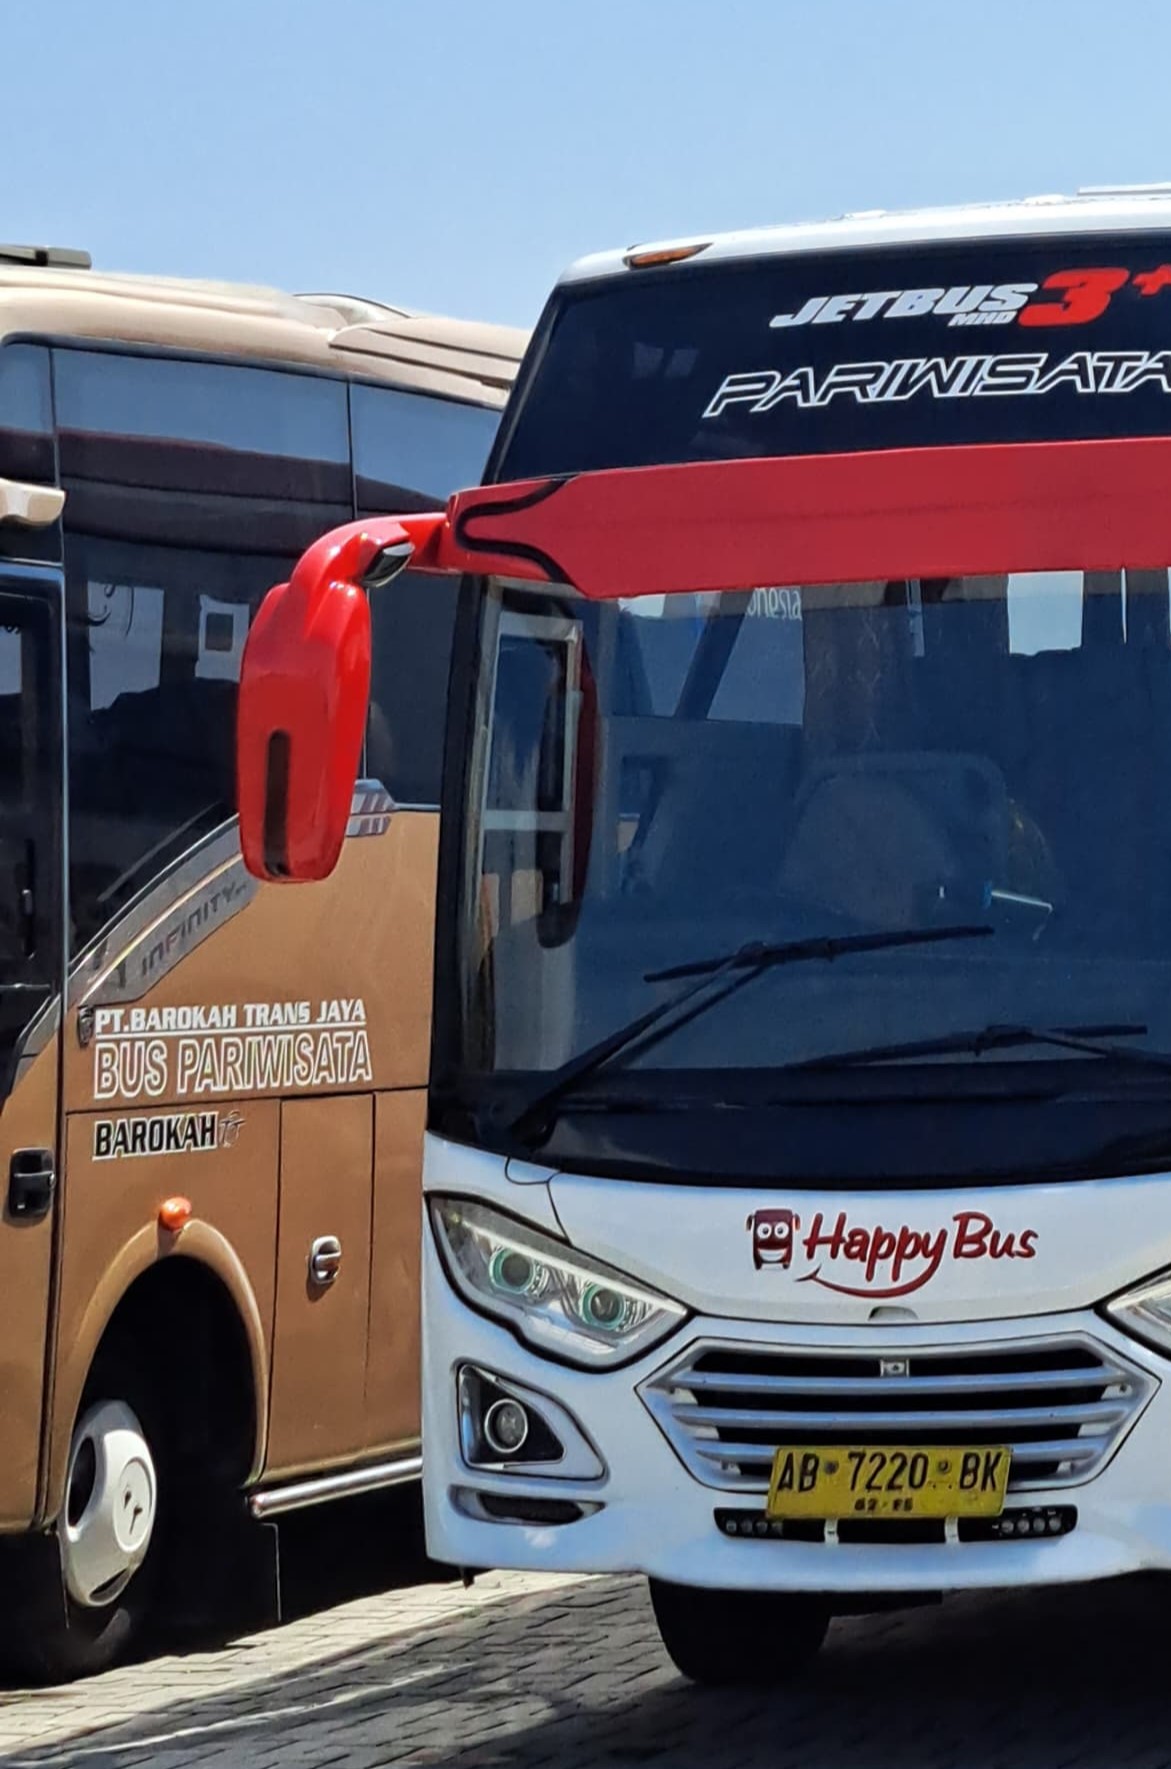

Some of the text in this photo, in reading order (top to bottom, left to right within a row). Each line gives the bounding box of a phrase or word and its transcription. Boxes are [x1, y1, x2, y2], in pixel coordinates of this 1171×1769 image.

[769, 283, 1038, 328] JETBUS
[243, 1001, 310, 1027] TRANS
[316, 999, 367, 1023] JAYA
[94, 1030, 373, 1099] BUS PARIWISATA
[92, 1110, 219, 1161] BAROKAH
[797, 1211, 1039, 1298] Happy Bus
[777, 1451, 1003, 1493] AB 7220 BK
